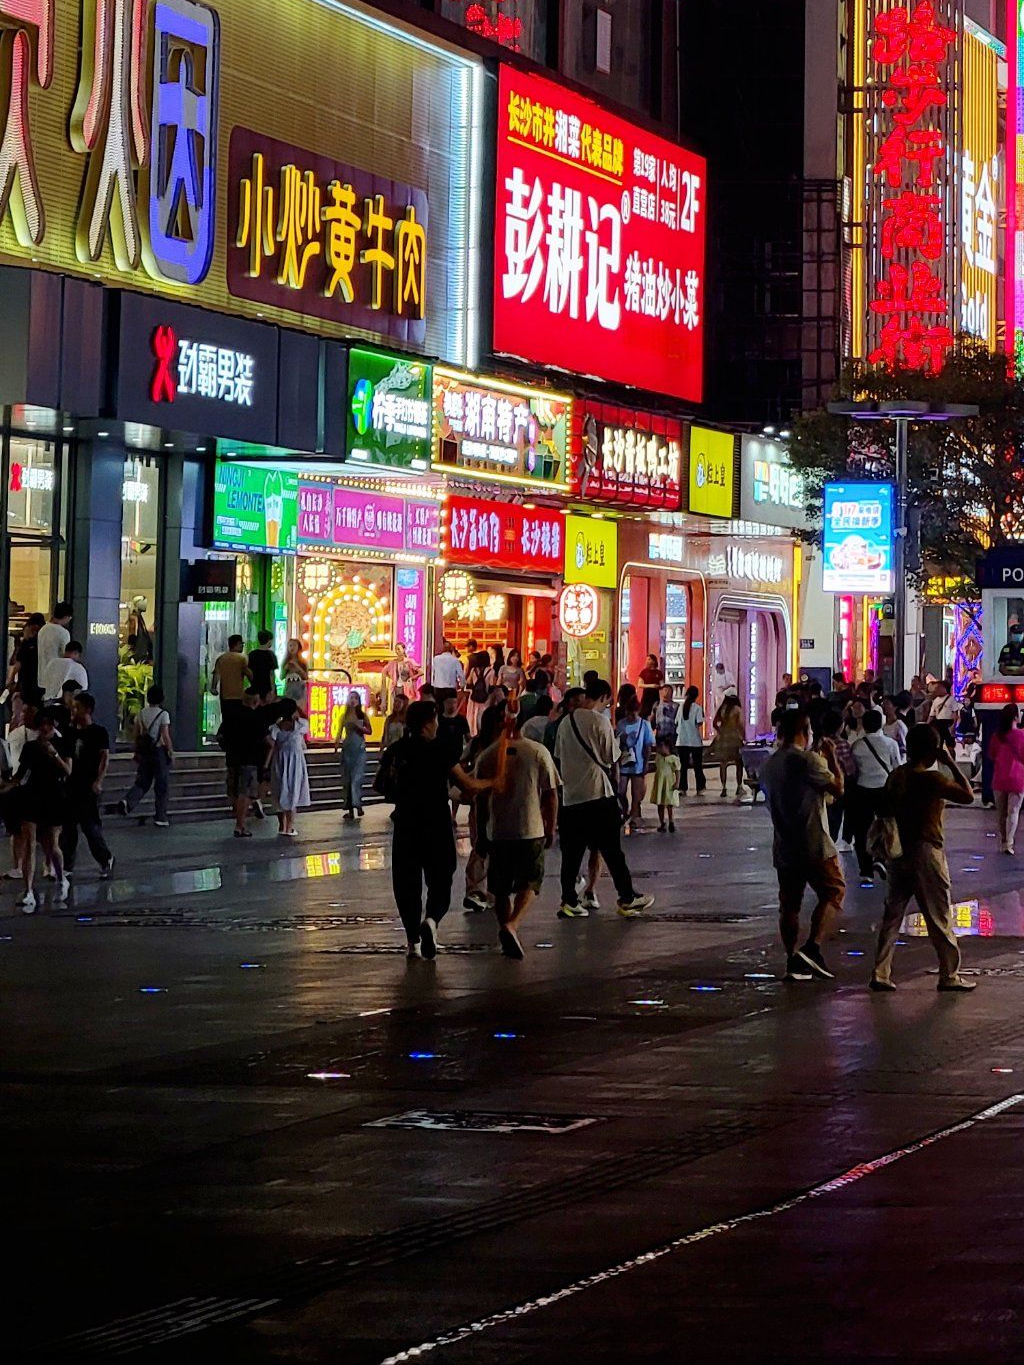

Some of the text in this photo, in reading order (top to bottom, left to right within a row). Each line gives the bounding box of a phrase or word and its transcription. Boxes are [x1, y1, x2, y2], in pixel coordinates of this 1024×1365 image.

[507, 90, 624, 177] 长沙市井湘菜代表品牌
[661, 160, 678, 192] 人均
[681, 170, 700, 234] 2F
[236, 153, 426, 320] 小炒黄牛肉
[661, 199, 678, 231] 38元
[503, 167, 622, 331] 彭耕记
[178, 339, 255, 406] 劲霸男装
[465, 391, 529, 445] 湖南特产
